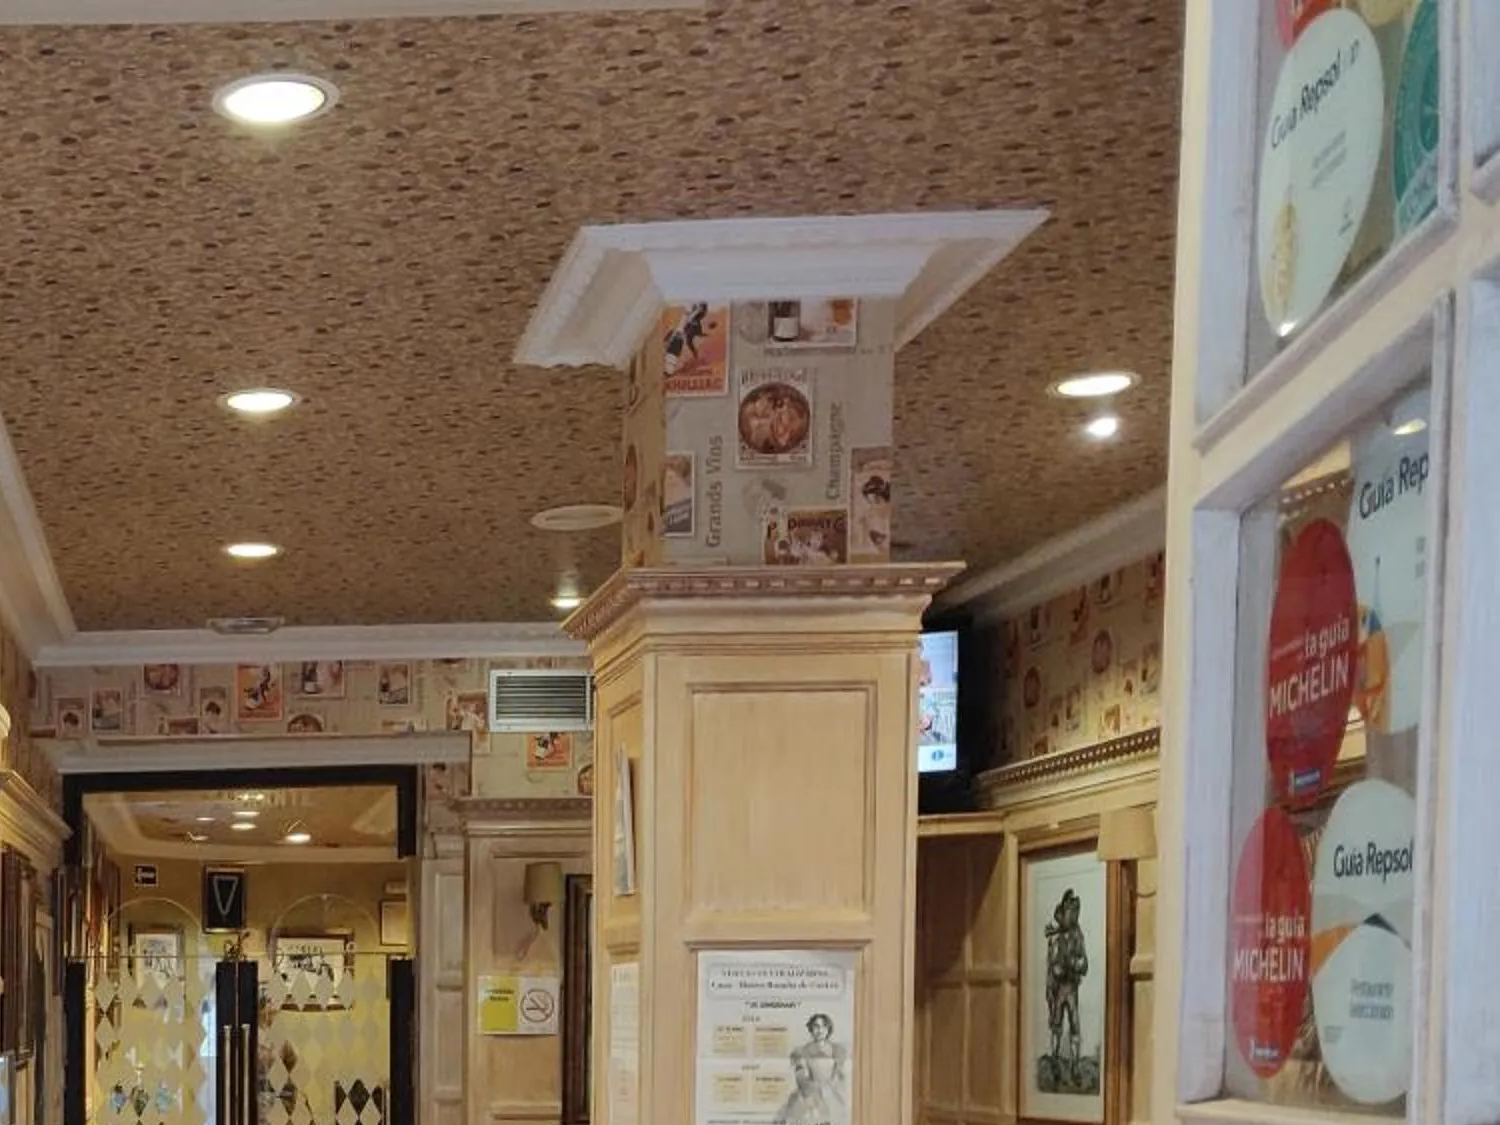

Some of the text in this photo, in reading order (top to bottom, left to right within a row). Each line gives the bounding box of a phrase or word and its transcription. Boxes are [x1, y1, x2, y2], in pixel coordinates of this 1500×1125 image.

[1268, 651, 1349, 719] MICHELIN
[1366, 836, 1414, 884] Repsol
[1234, 946, 1304, 982] MICHELIN
